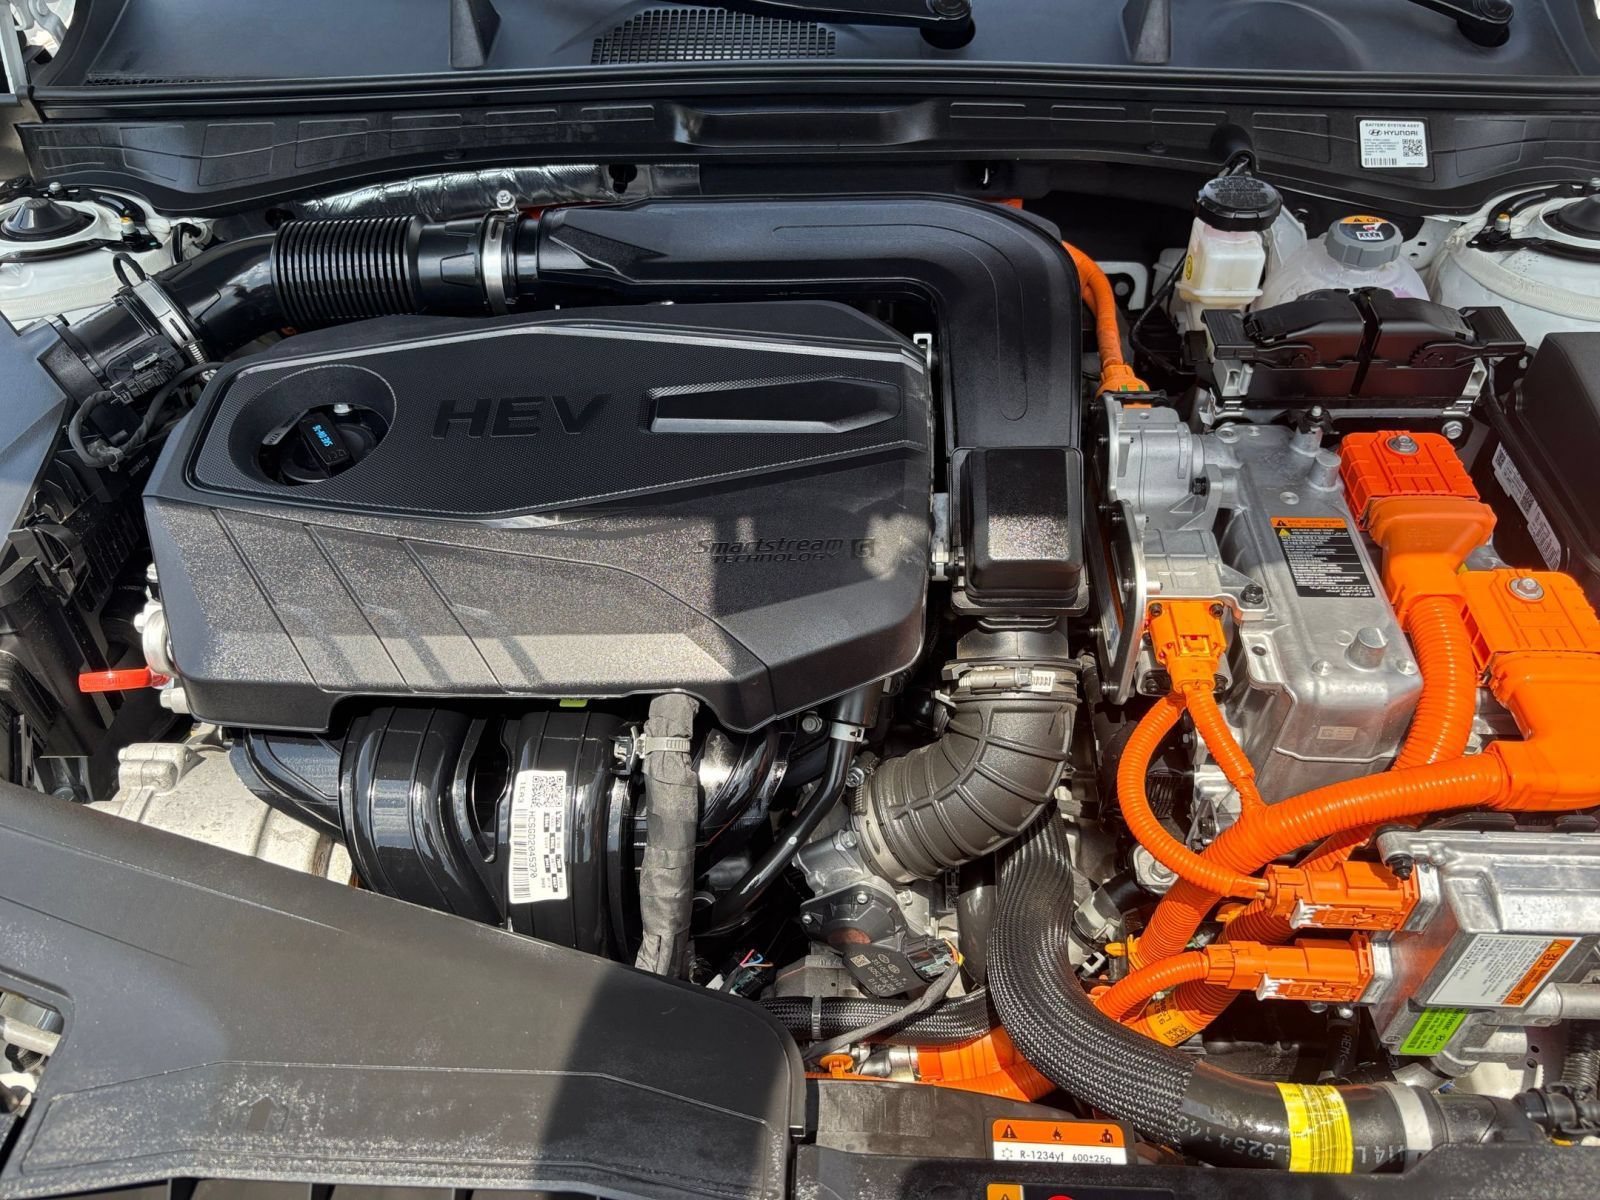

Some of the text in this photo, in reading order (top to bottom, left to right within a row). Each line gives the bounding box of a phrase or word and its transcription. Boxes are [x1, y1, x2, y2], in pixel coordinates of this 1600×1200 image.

[431, 393, 612, 440] HEV
[694, 537, 844, 554] Smartstream
[713, 553, 840, 564] TECHNOLOGY
[1020, 1150, 1064, 1162] R-1234yf
